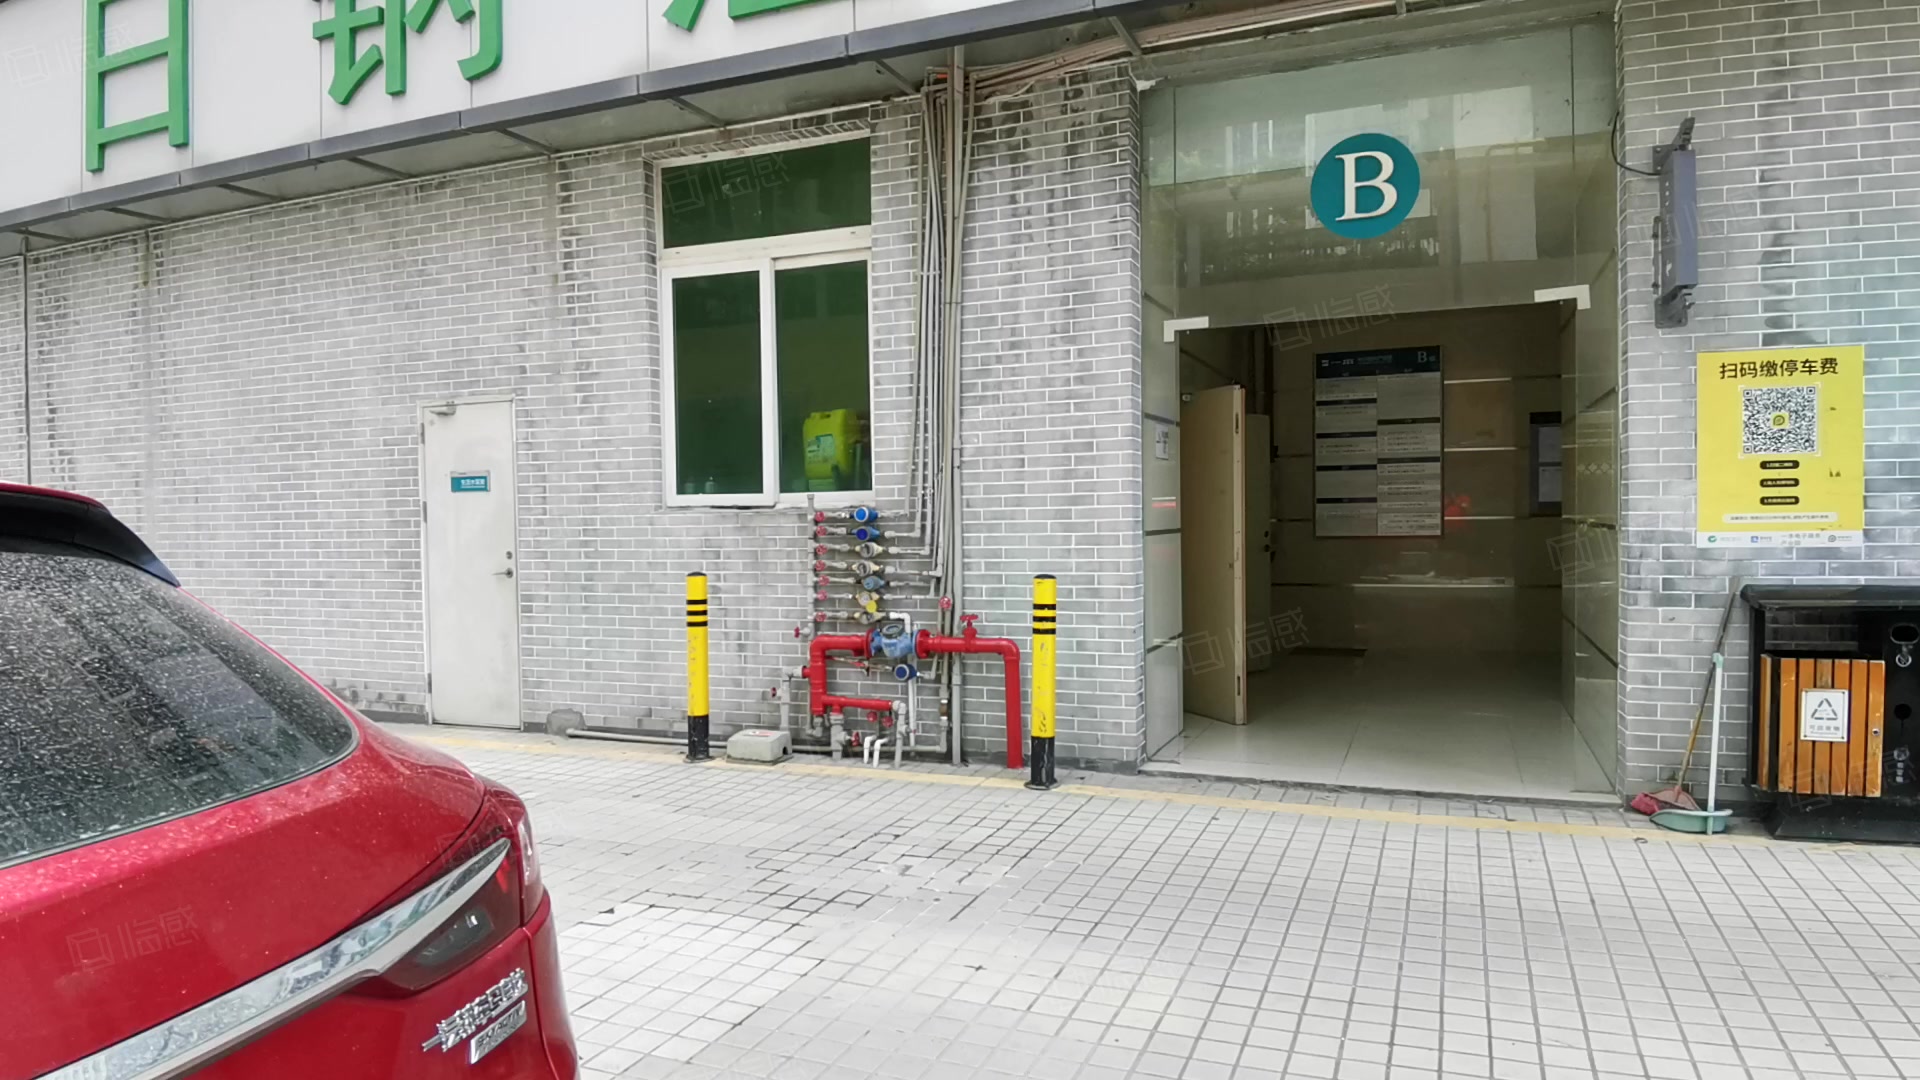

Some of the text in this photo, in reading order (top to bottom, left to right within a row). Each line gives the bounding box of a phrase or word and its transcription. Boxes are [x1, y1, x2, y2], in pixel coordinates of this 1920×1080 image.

[1334, 151, 1398, 222] B
[1719, 357, 1839, 380] 扫码缴停车费
